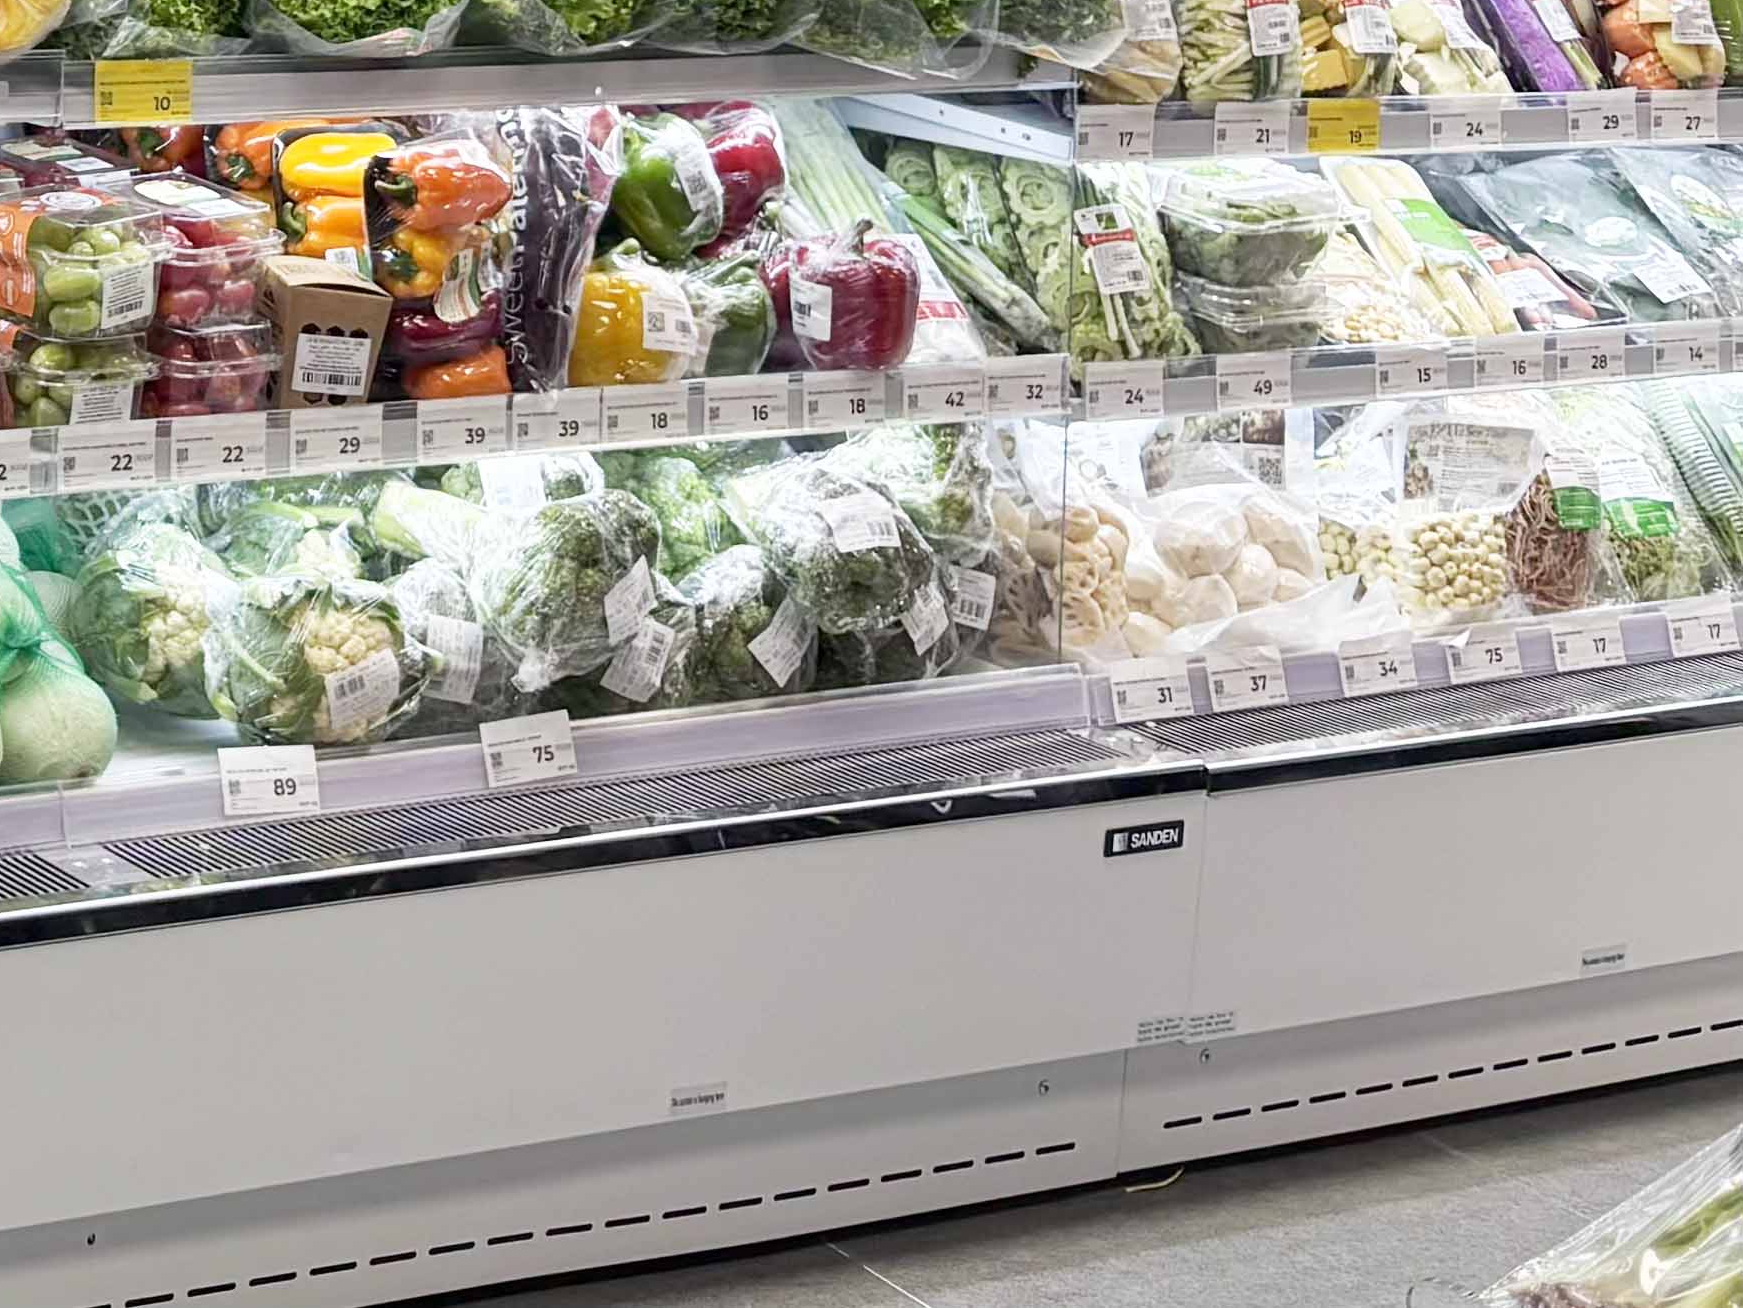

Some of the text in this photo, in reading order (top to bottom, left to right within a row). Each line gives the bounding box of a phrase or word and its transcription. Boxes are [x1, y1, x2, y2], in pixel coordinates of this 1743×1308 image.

[153, 96, 171, 111] 10
[1603, 115, 1619, 130] 29
[1256, 128, 1269, 143] 21
[1417, 368, 1431, 383] 15
[1125, 388, 1143, 404] 24
[849, 398, 865, 414] 18
[651, 412, 668, 429] 18
[465, 427, 485, 444] 39
[111, 454, 132, 471] 22
[1485, 647, 1503, 664] 75
[1250, 675, 1266, 692] 37
[532, 745, 554, 763] 75
[1131, 828, 1179, 849] SANDEN
